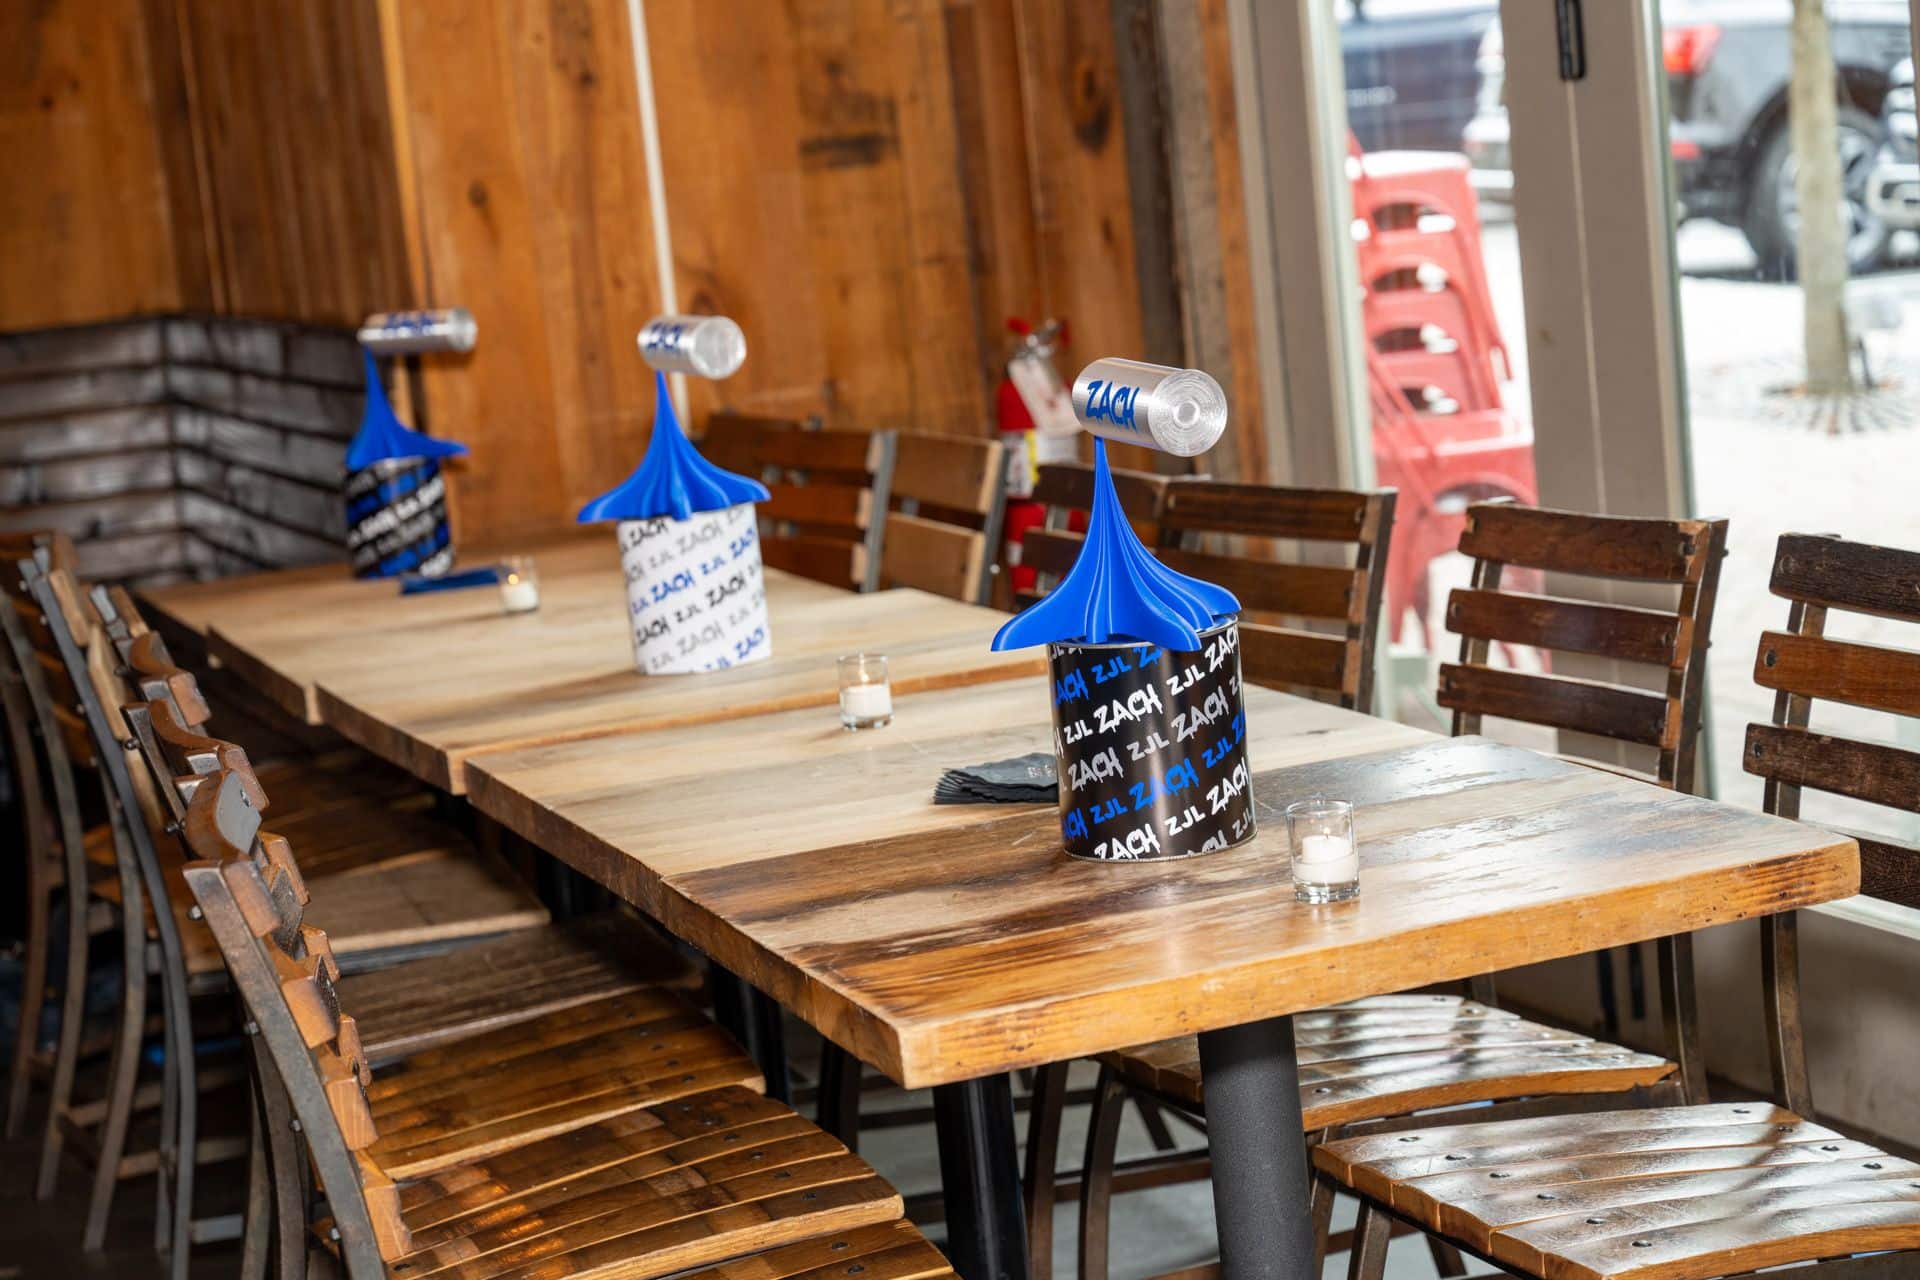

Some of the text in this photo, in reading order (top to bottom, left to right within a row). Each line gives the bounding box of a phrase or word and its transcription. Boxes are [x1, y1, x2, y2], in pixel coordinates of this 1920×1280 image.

[1086, 380, 1140, 433] ZACH
[651, 568, 695, 603] ZACH
[706, 571, 747, 608] ZACH
[1056, 668, 1089, 704] ACH
[1091, 656, 1132, 684] ZJL
[1064, 719, 1094, 744] ZJL
[1093, 683, 1163, 733] ZACH
[1166, 664, 1206, 696] ZJL
[1067, 747, 1124, 791] ZACH
[1126, 732, 1170, 761] ZJL
[1171, 685, 1229, 743] ZACH
[1089, 798, 1128, 824] ZJL
[1129, 758, 1199, 811] ZACH
[1202, 737, 1232, 769] ZJL
[1094, 757, 1249, 860] ZACH ZJL ZACH
